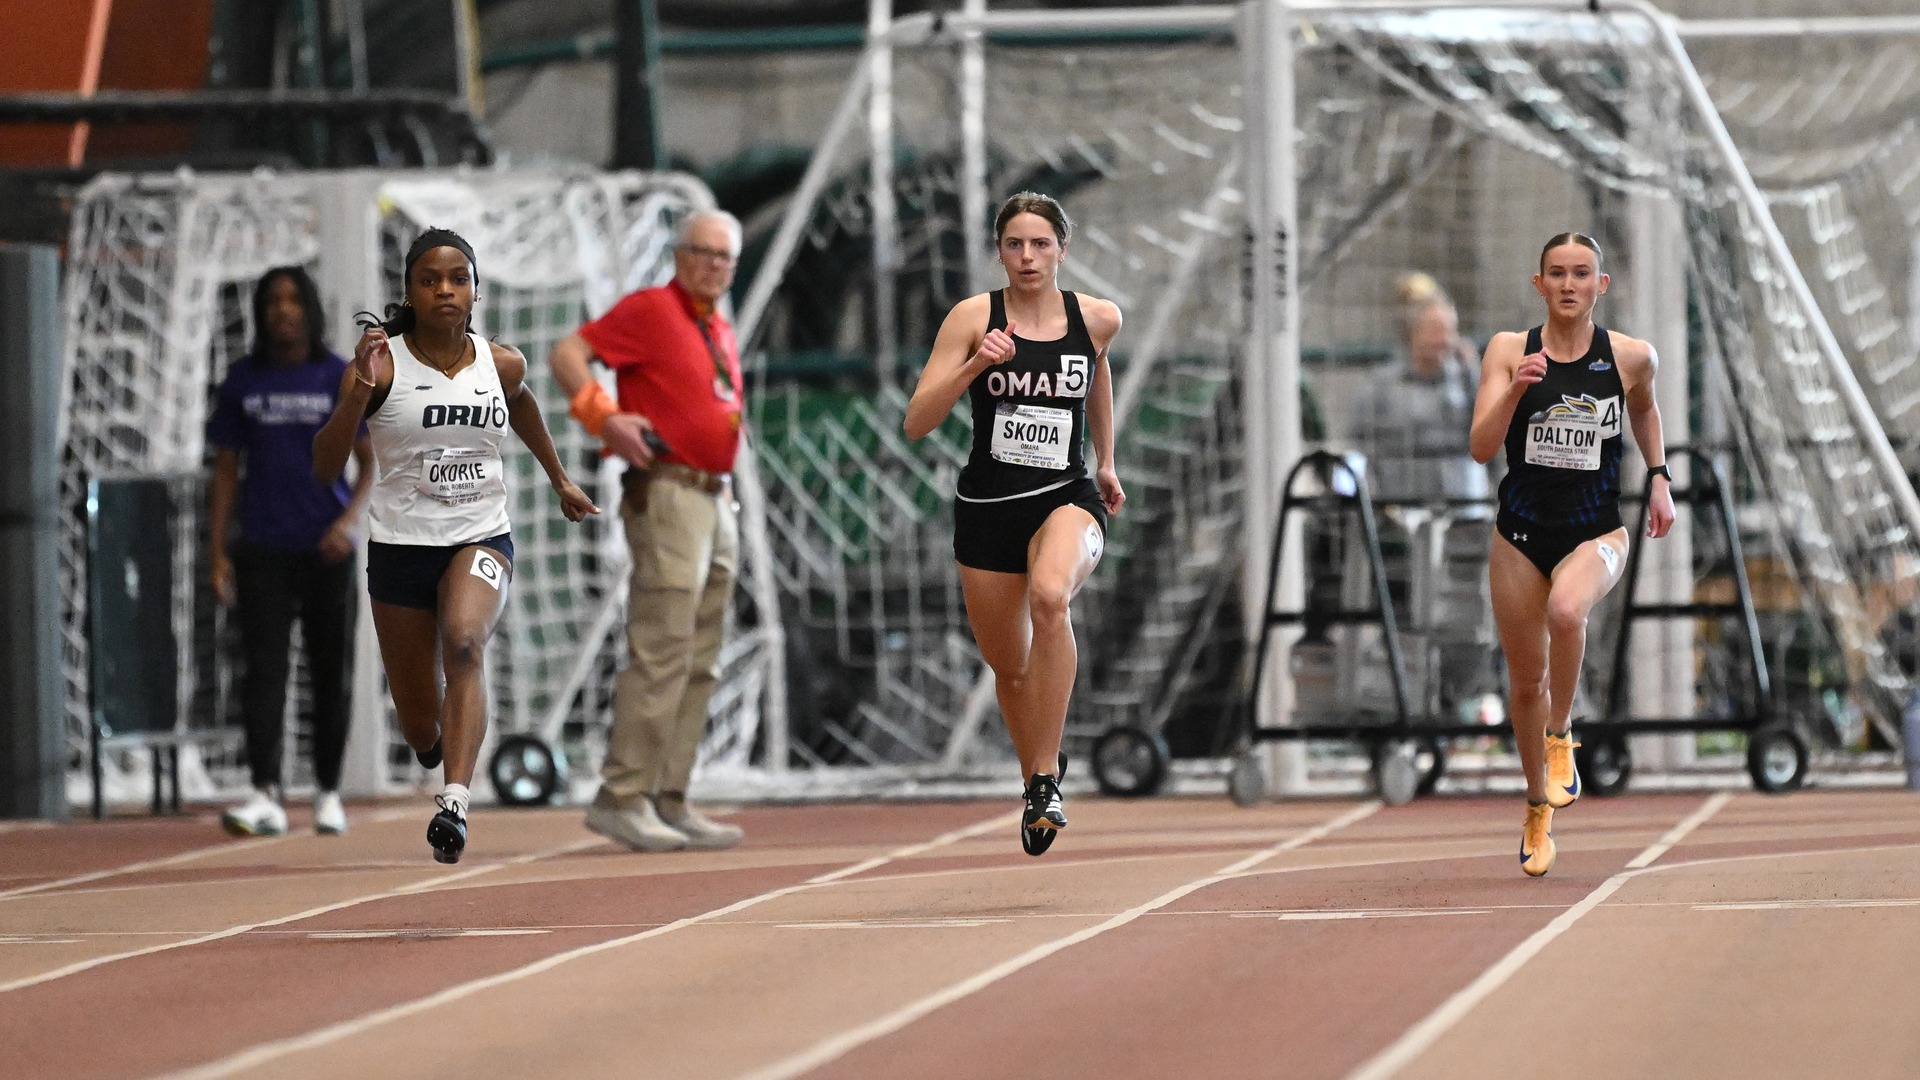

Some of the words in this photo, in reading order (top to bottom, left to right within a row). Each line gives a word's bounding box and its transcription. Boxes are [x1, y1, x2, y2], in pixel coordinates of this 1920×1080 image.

[1065, 359, 1084, 391] 5
[422, 404, 490, 429] ORU
[492, 396, 506, 428] 6
[1600, 401, 1618, 431] 4
[1003, 420, 1059, 445] SKODA
[1533, 426, 1596, 447] DALTON
[1020, 443, 1039, 451] OMAHA
[1537, 444, 1553, 452] SOUTH
[1554, 446, 1573, 454] DAKOTA
[429, 463, 486, 483] OKORIE
[451, 482, 475, 491] ROBERTS
[478, 557, 497, 580] 6
